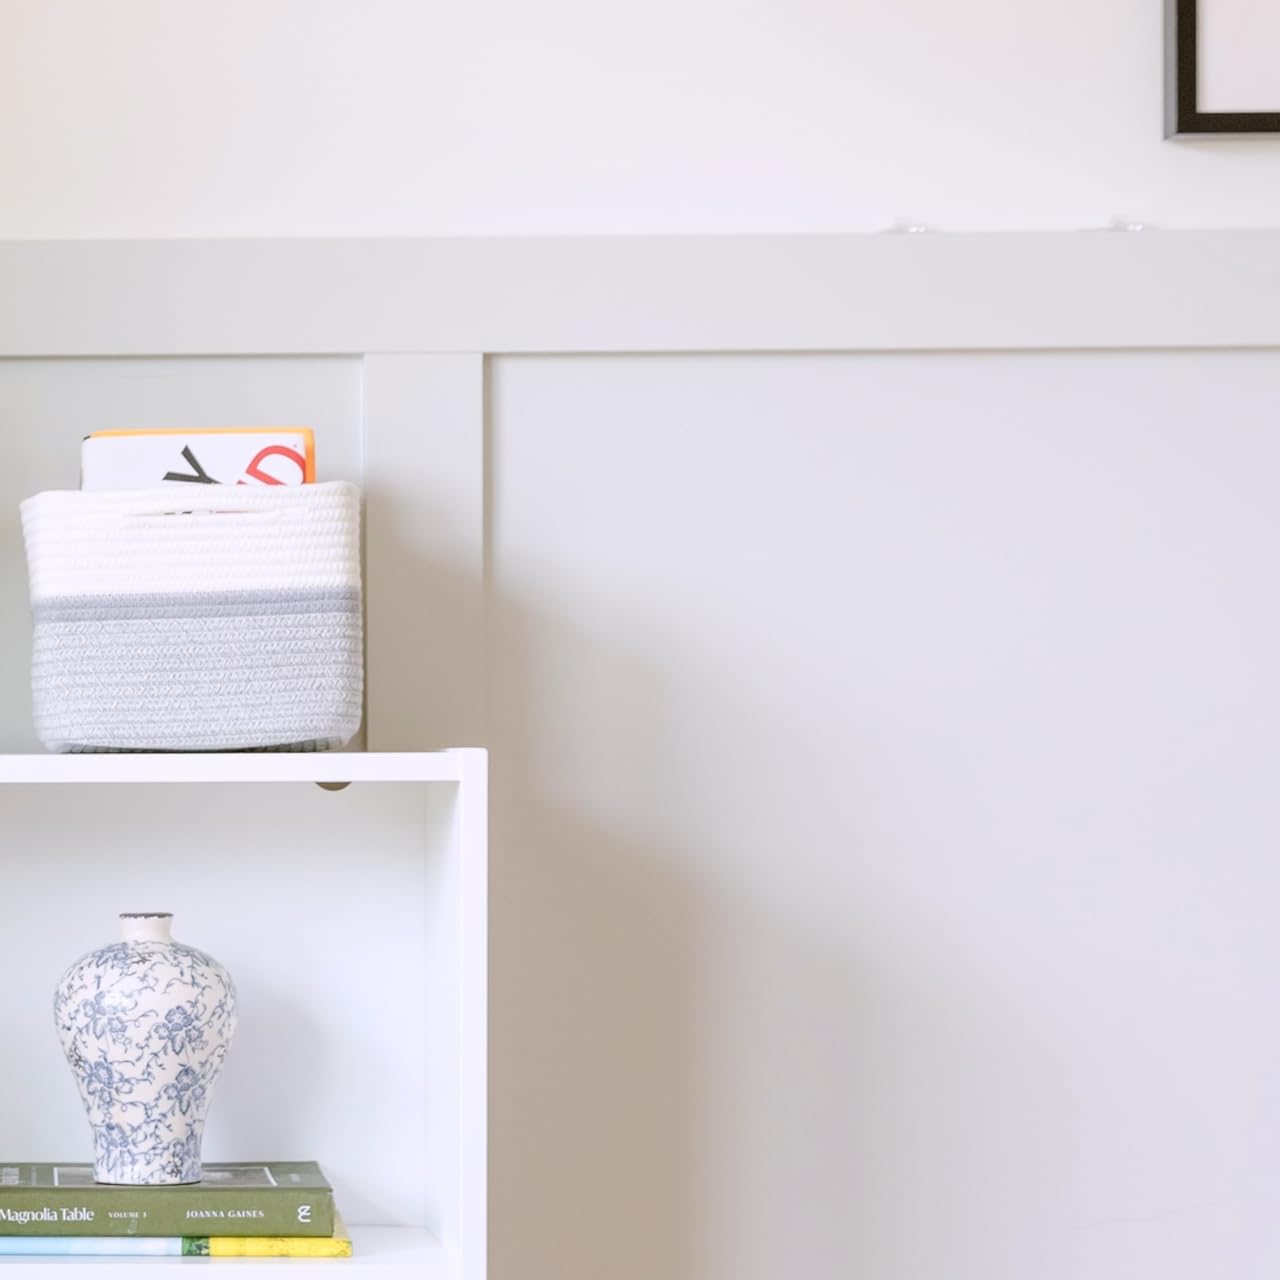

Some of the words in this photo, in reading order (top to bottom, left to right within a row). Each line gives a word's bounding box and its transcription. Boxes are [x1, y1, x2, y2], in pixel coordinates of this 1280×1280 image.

[60, 1207, 95, 1222] Table
[108, 1211, 139, 1219] VOLUME
[186, 1210, 225, 1219] JOANNA
[228, 1209, 265, 1218] GAINES
